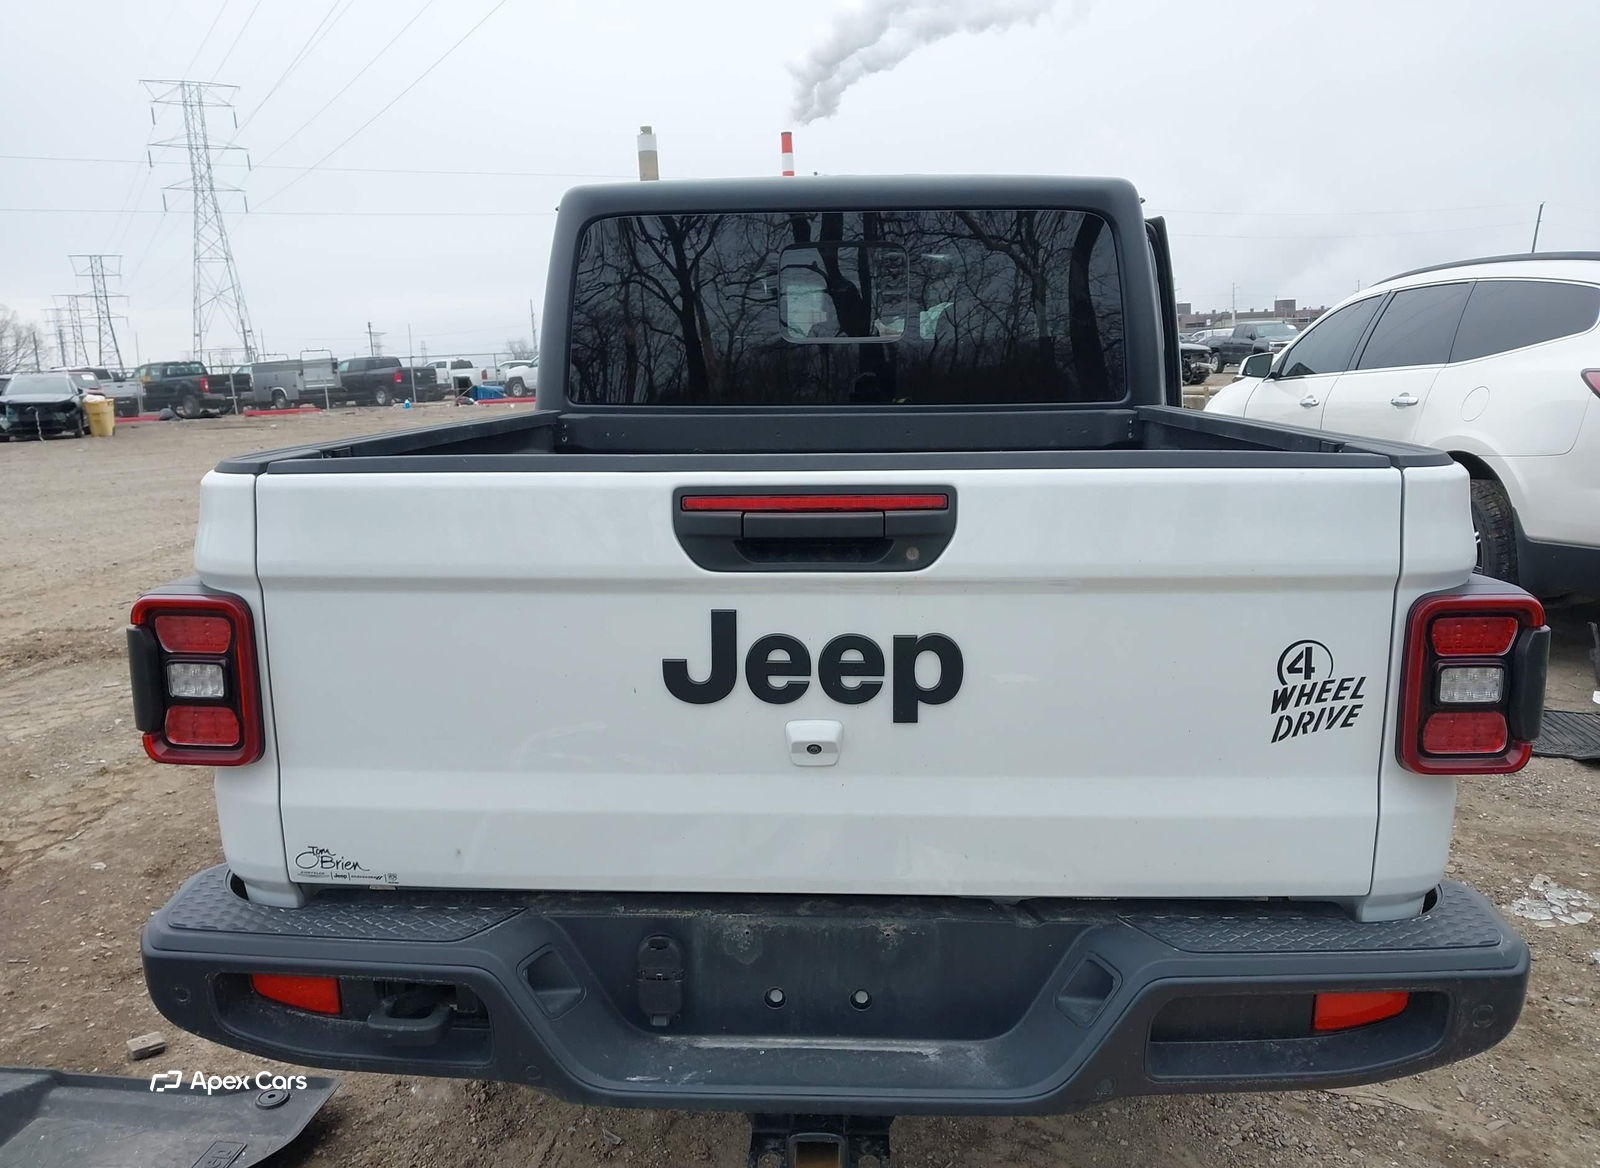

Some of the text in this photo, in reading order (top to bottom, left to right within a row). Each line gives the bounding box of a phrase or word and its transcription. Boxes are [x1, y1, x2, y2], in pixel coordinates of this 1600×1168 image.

[662, 609, 964, 723] Jeep
[1286, 646, 1315, 680] 4
[1271, 676, 1366, 714] WHEEL
[1271, 704, 1363, 743] DRIVE
[307, 845, 336, 856] Tom
